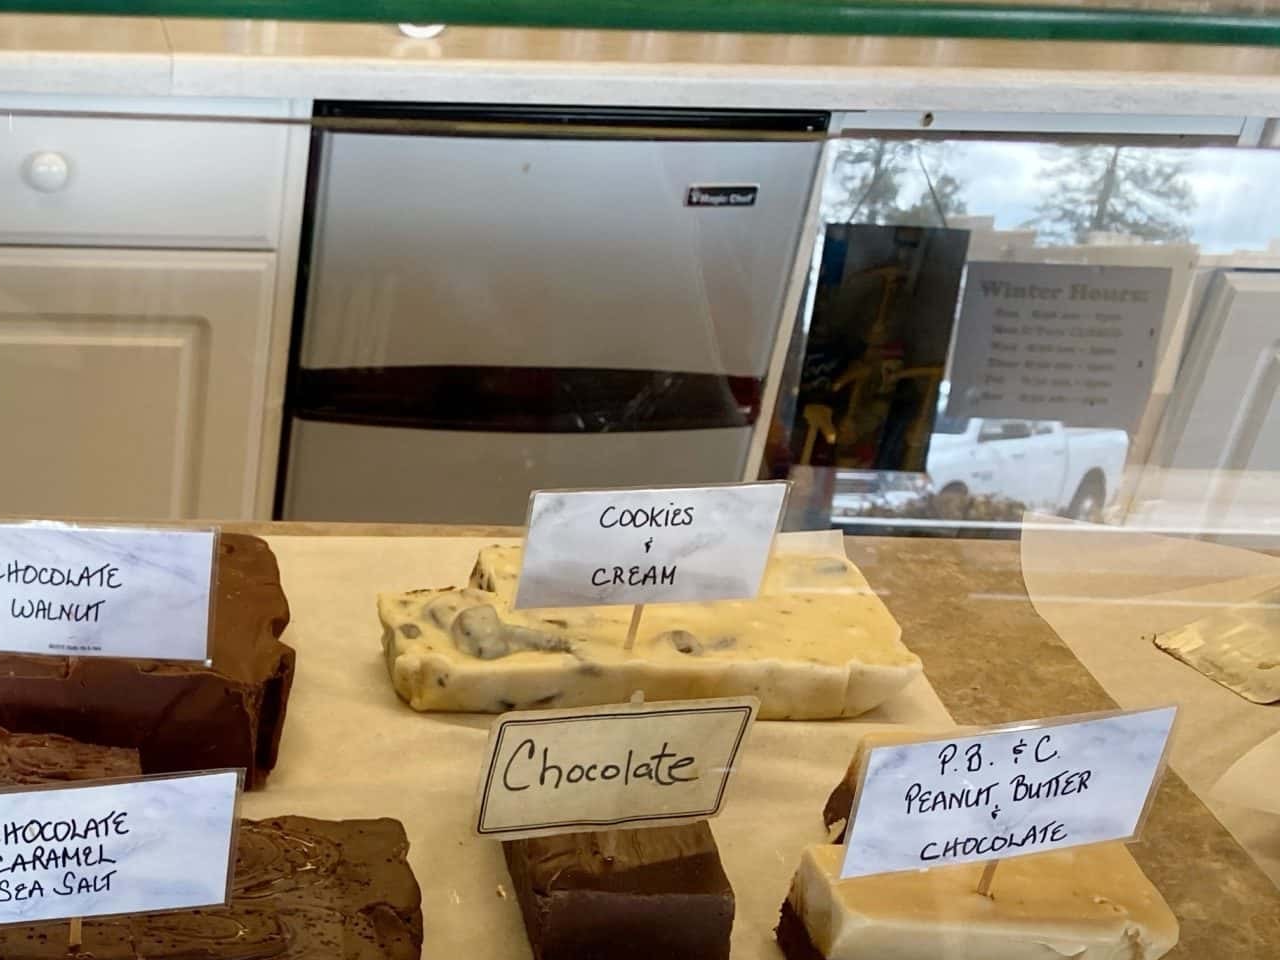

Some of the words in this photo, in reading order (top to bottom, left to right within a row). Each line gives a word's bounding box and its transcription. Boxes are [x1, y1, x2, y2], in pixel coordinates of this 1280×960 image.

[980, 281, 1064, 299] Winter
[591, 565, 677, 587] CREAM
[11, 598, 106, 623] WALNUT
[1012, 738, 1028, 764] &
[503, 738, 700, 792] Chocolate
[904, 782, 999, 814] PEANUT
[1009, 770, 1092, 802] BUTTER
[920, 821, 1068, 861] CHOCOLATE
[52, 869, 118, 896] SALT
